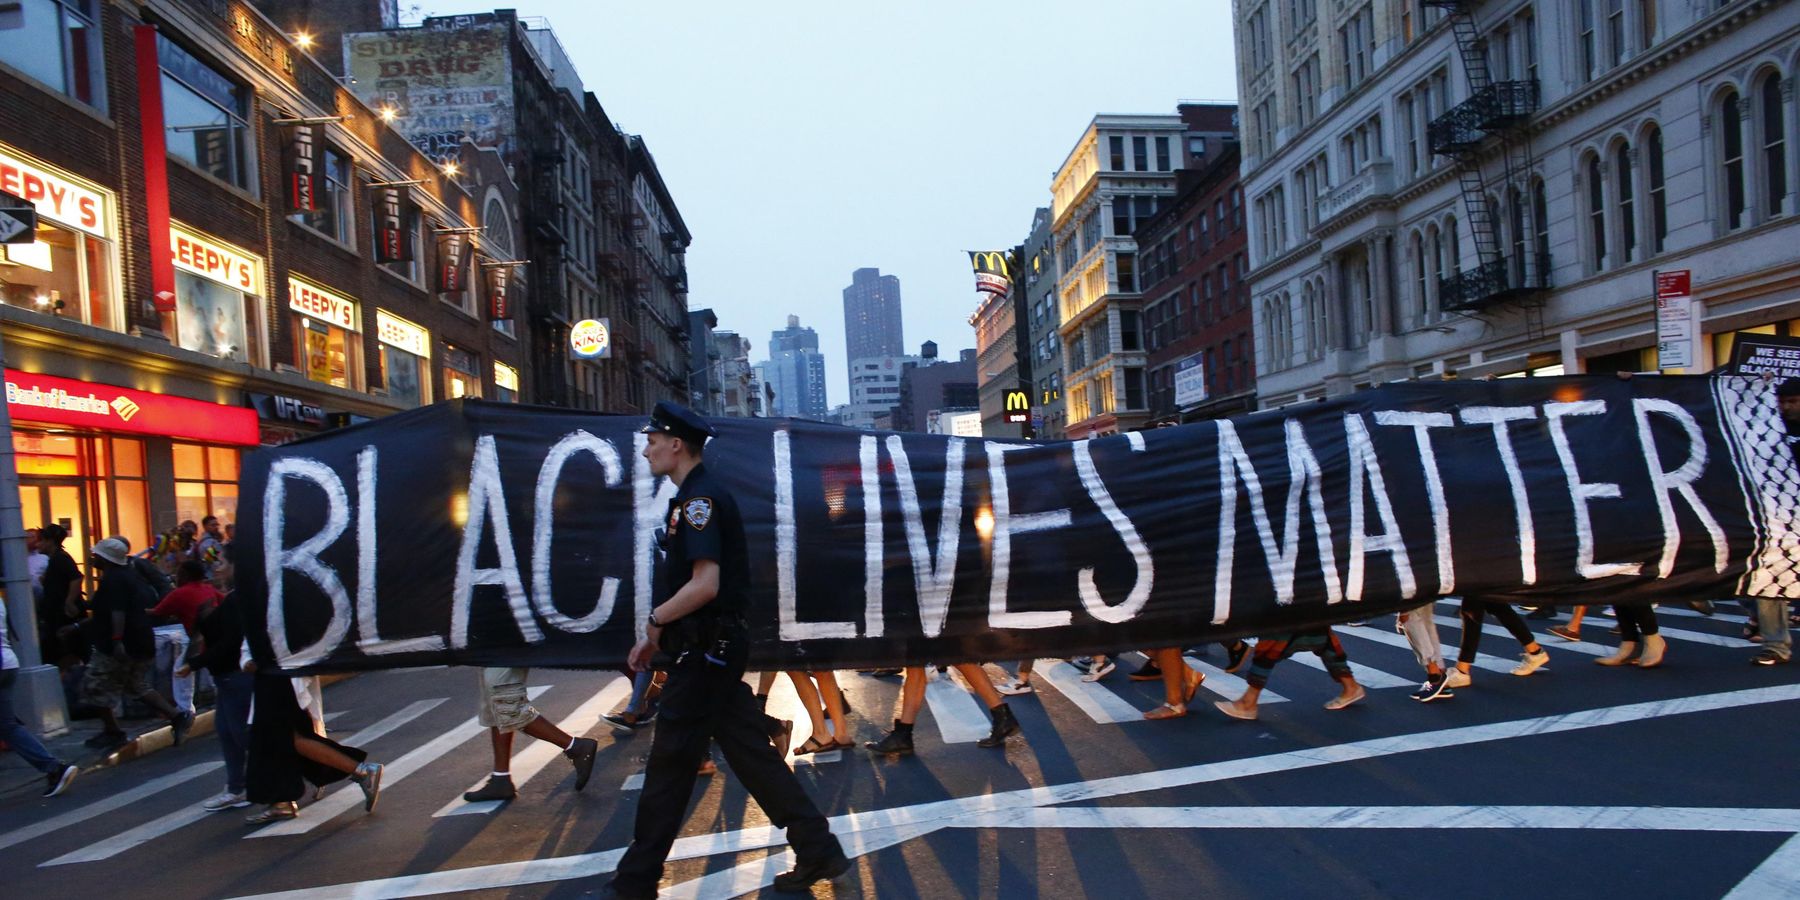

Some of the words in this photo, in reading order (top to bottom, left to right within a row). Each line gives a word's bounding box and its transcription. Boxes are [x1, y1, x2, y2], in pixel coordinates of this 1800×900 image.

[378, 55, 480, 78] DRUG
[295, 126, 313, 174] UFC
[574, 333, 604, 349] KING
[1755, 347, 1775, 357] WE
[1776, 349, 1800, 359] SEE
[1739, 364, 1780, 376] BLACK
[5, 382, 45, 407] Bank
[59, 389, 109, 414] America
[274, 395, 304, 421] UFC
[773, 430, 1154, 641] LIVES
[1210, 398, 1729, 625] MATTER
